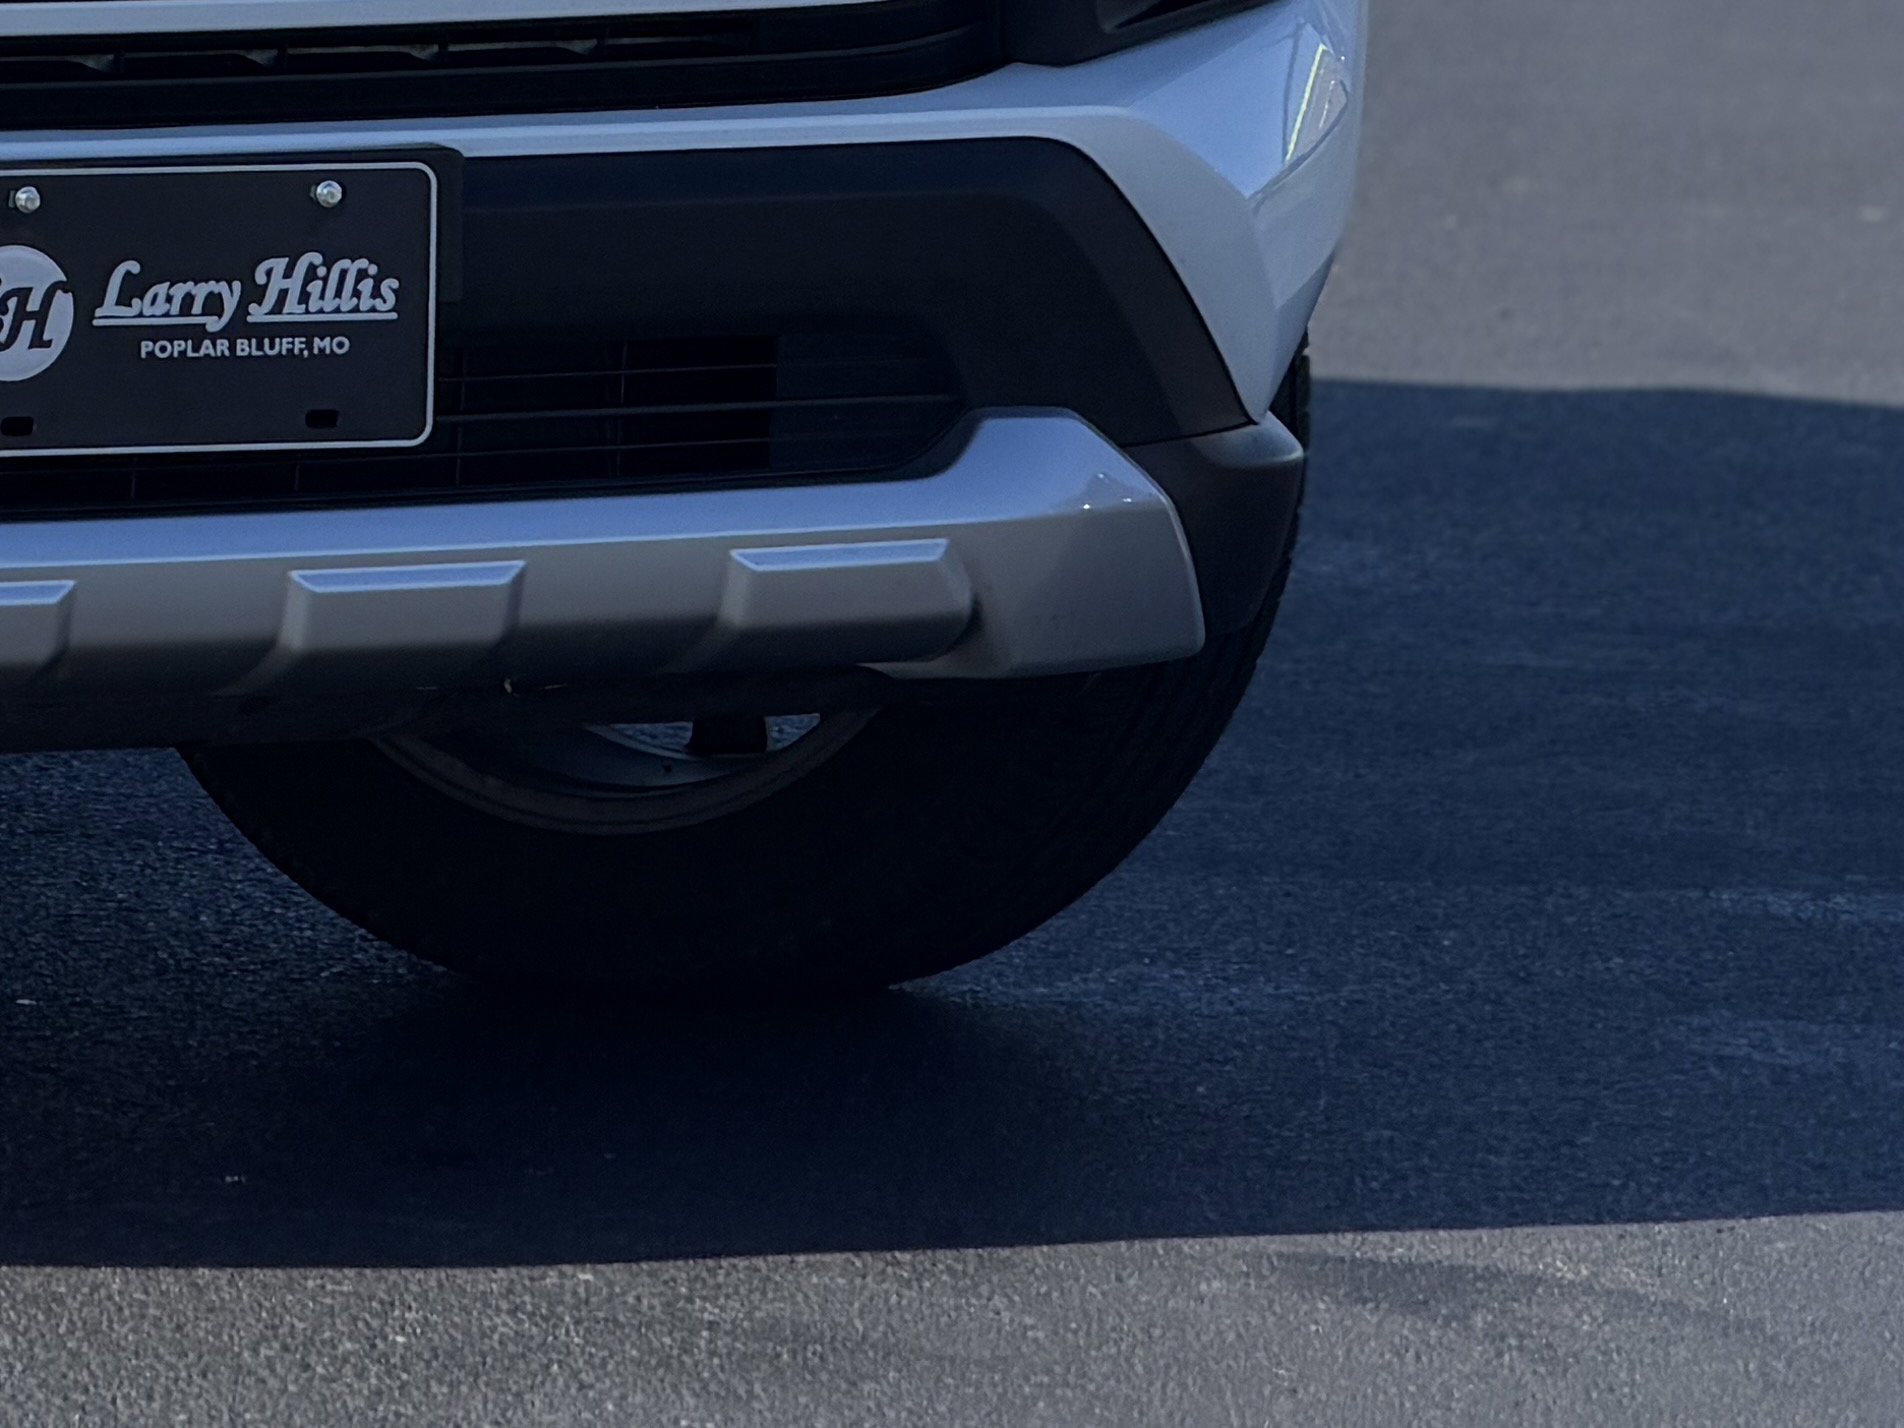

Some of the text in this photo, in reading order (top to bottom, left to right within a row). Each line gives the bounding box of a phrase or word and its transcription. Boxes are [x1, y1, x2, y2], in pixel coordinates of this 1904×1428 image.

[94, 251, 400, 333] Larry Hillis
[140, 336, 351, 360] POPLAR BLUFF, MO
